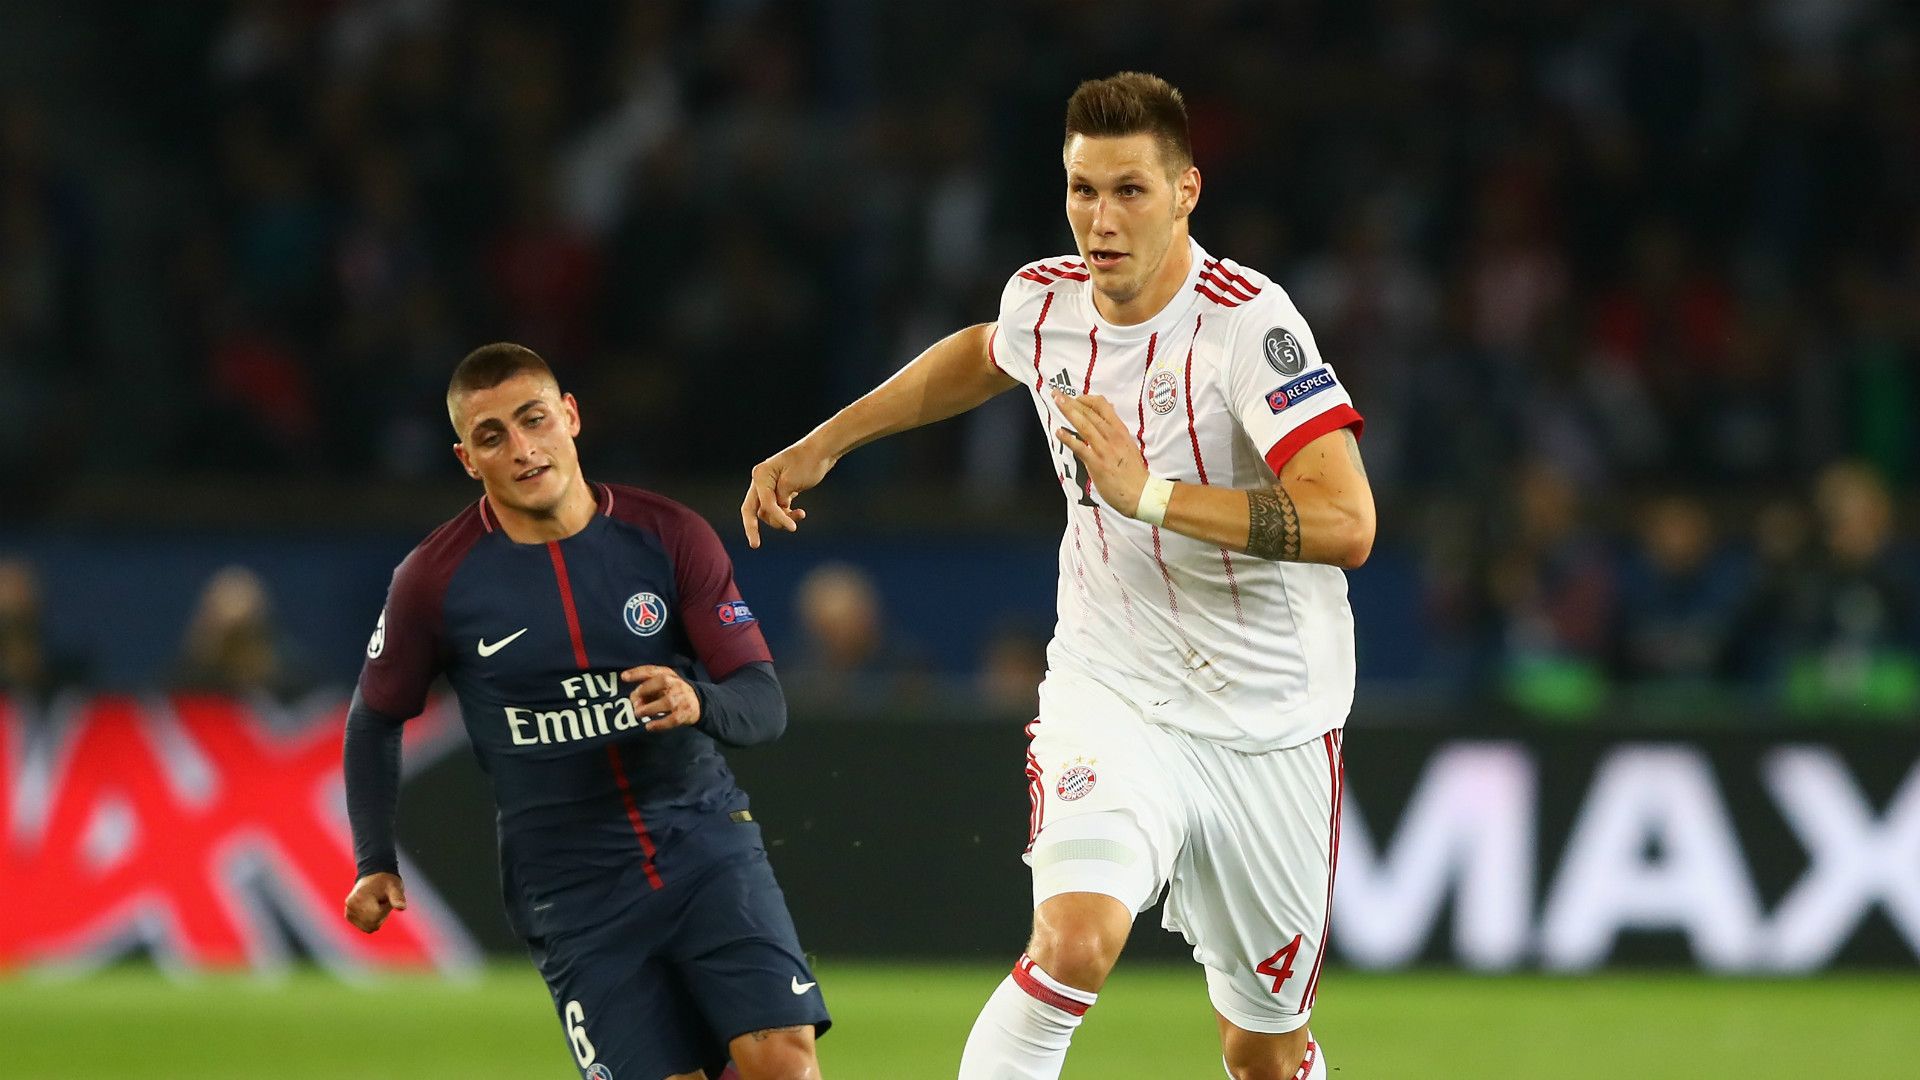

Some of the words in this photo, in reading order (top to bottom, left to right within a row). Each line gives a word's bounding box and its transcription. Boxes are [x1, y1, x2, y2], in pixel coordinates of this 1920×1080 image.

[1284, 350, 1295, 363] 5
[1286, 373, 1333, 400] RESPECT
[626, 594, 656, 609] PARIS
[561, 671, 618, 699] Fly
[504, 697, 666, 746] Emira
[0, 692, 458, 973] AX
[1326, 740, 1920, 970] MAX
[1256, 934, 1302, 994] 4
[565, 1000, 595, 1069] 6
